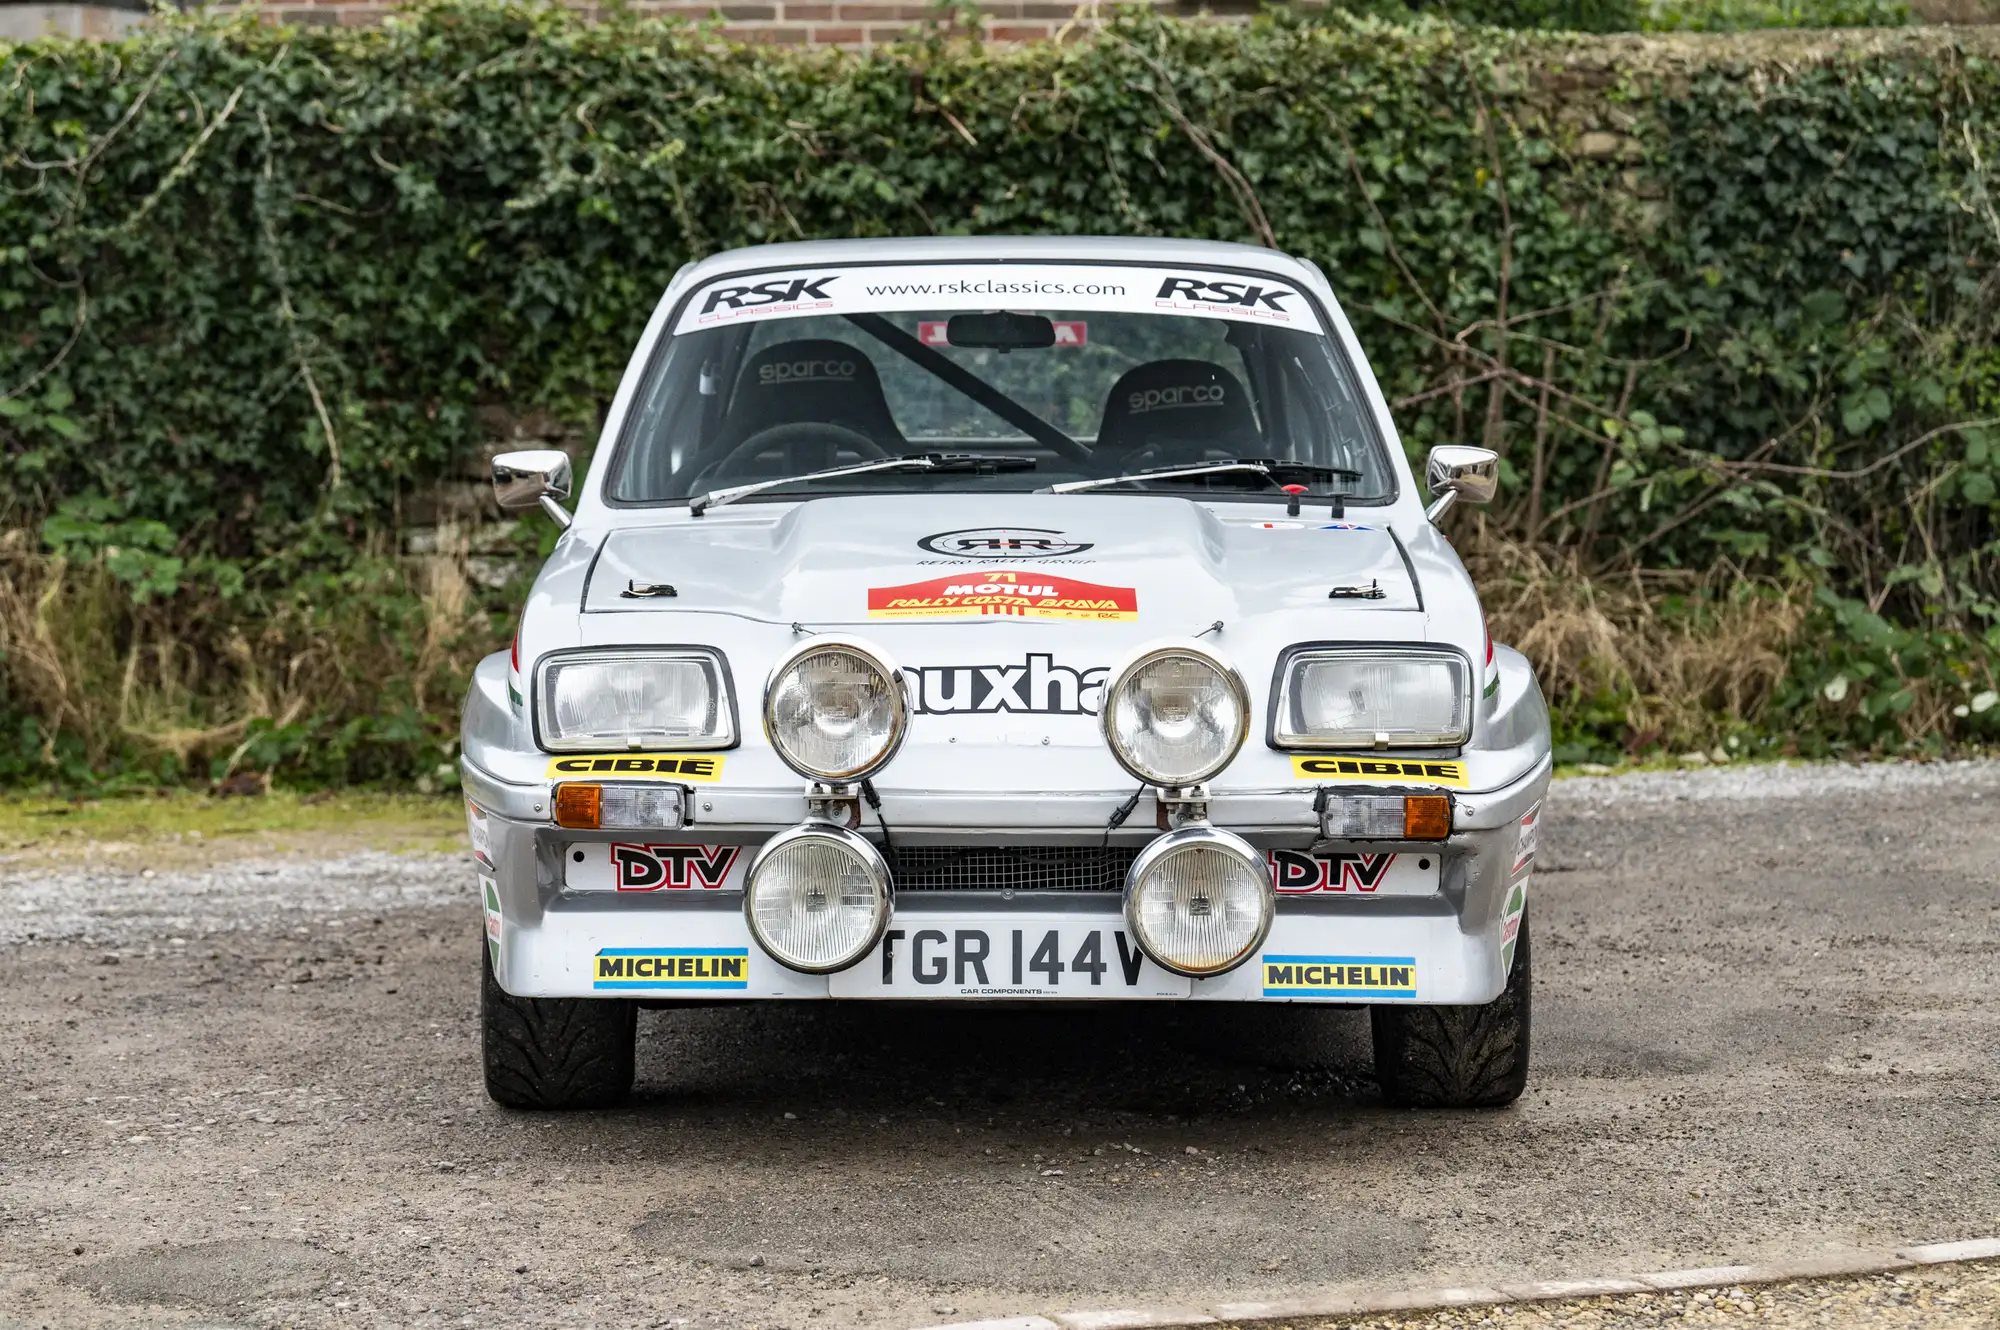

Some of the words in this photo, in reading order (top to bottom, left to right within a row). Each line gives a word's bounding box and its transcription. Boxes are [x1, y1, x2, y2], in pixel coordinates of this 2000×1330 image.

[700, 276, 842, 315] RSK
[866, 279, 1125, 297] www.rskclassics.com
[1156, 277, 1296, 313] RSK
[698, 300, 835, 324] CLASSICS
[1155, 300, 1290, 322] CLASSICS
[759, 358, 855, 383] sparco
[1129, 384, 1224, 412] sparco
[984, 572, 1017, 583] 71
[886, 597, 962, 609] RALLY
[961, 595, 1033, 607] COSTA
[1036, 598, 1119, 610] BRAVA
[943, 584, 1059, 597] MOTUL
[612, 845, 739, 889] DTV
[1271, 852, 1396, 890] DTV
[599, 958, 742, 978] MICHELIN
[882, 929, 990, 985] TGR
[1012, 929, 1144, 985] 144V
[1268, 965, 1410, 986] MICHELIN
